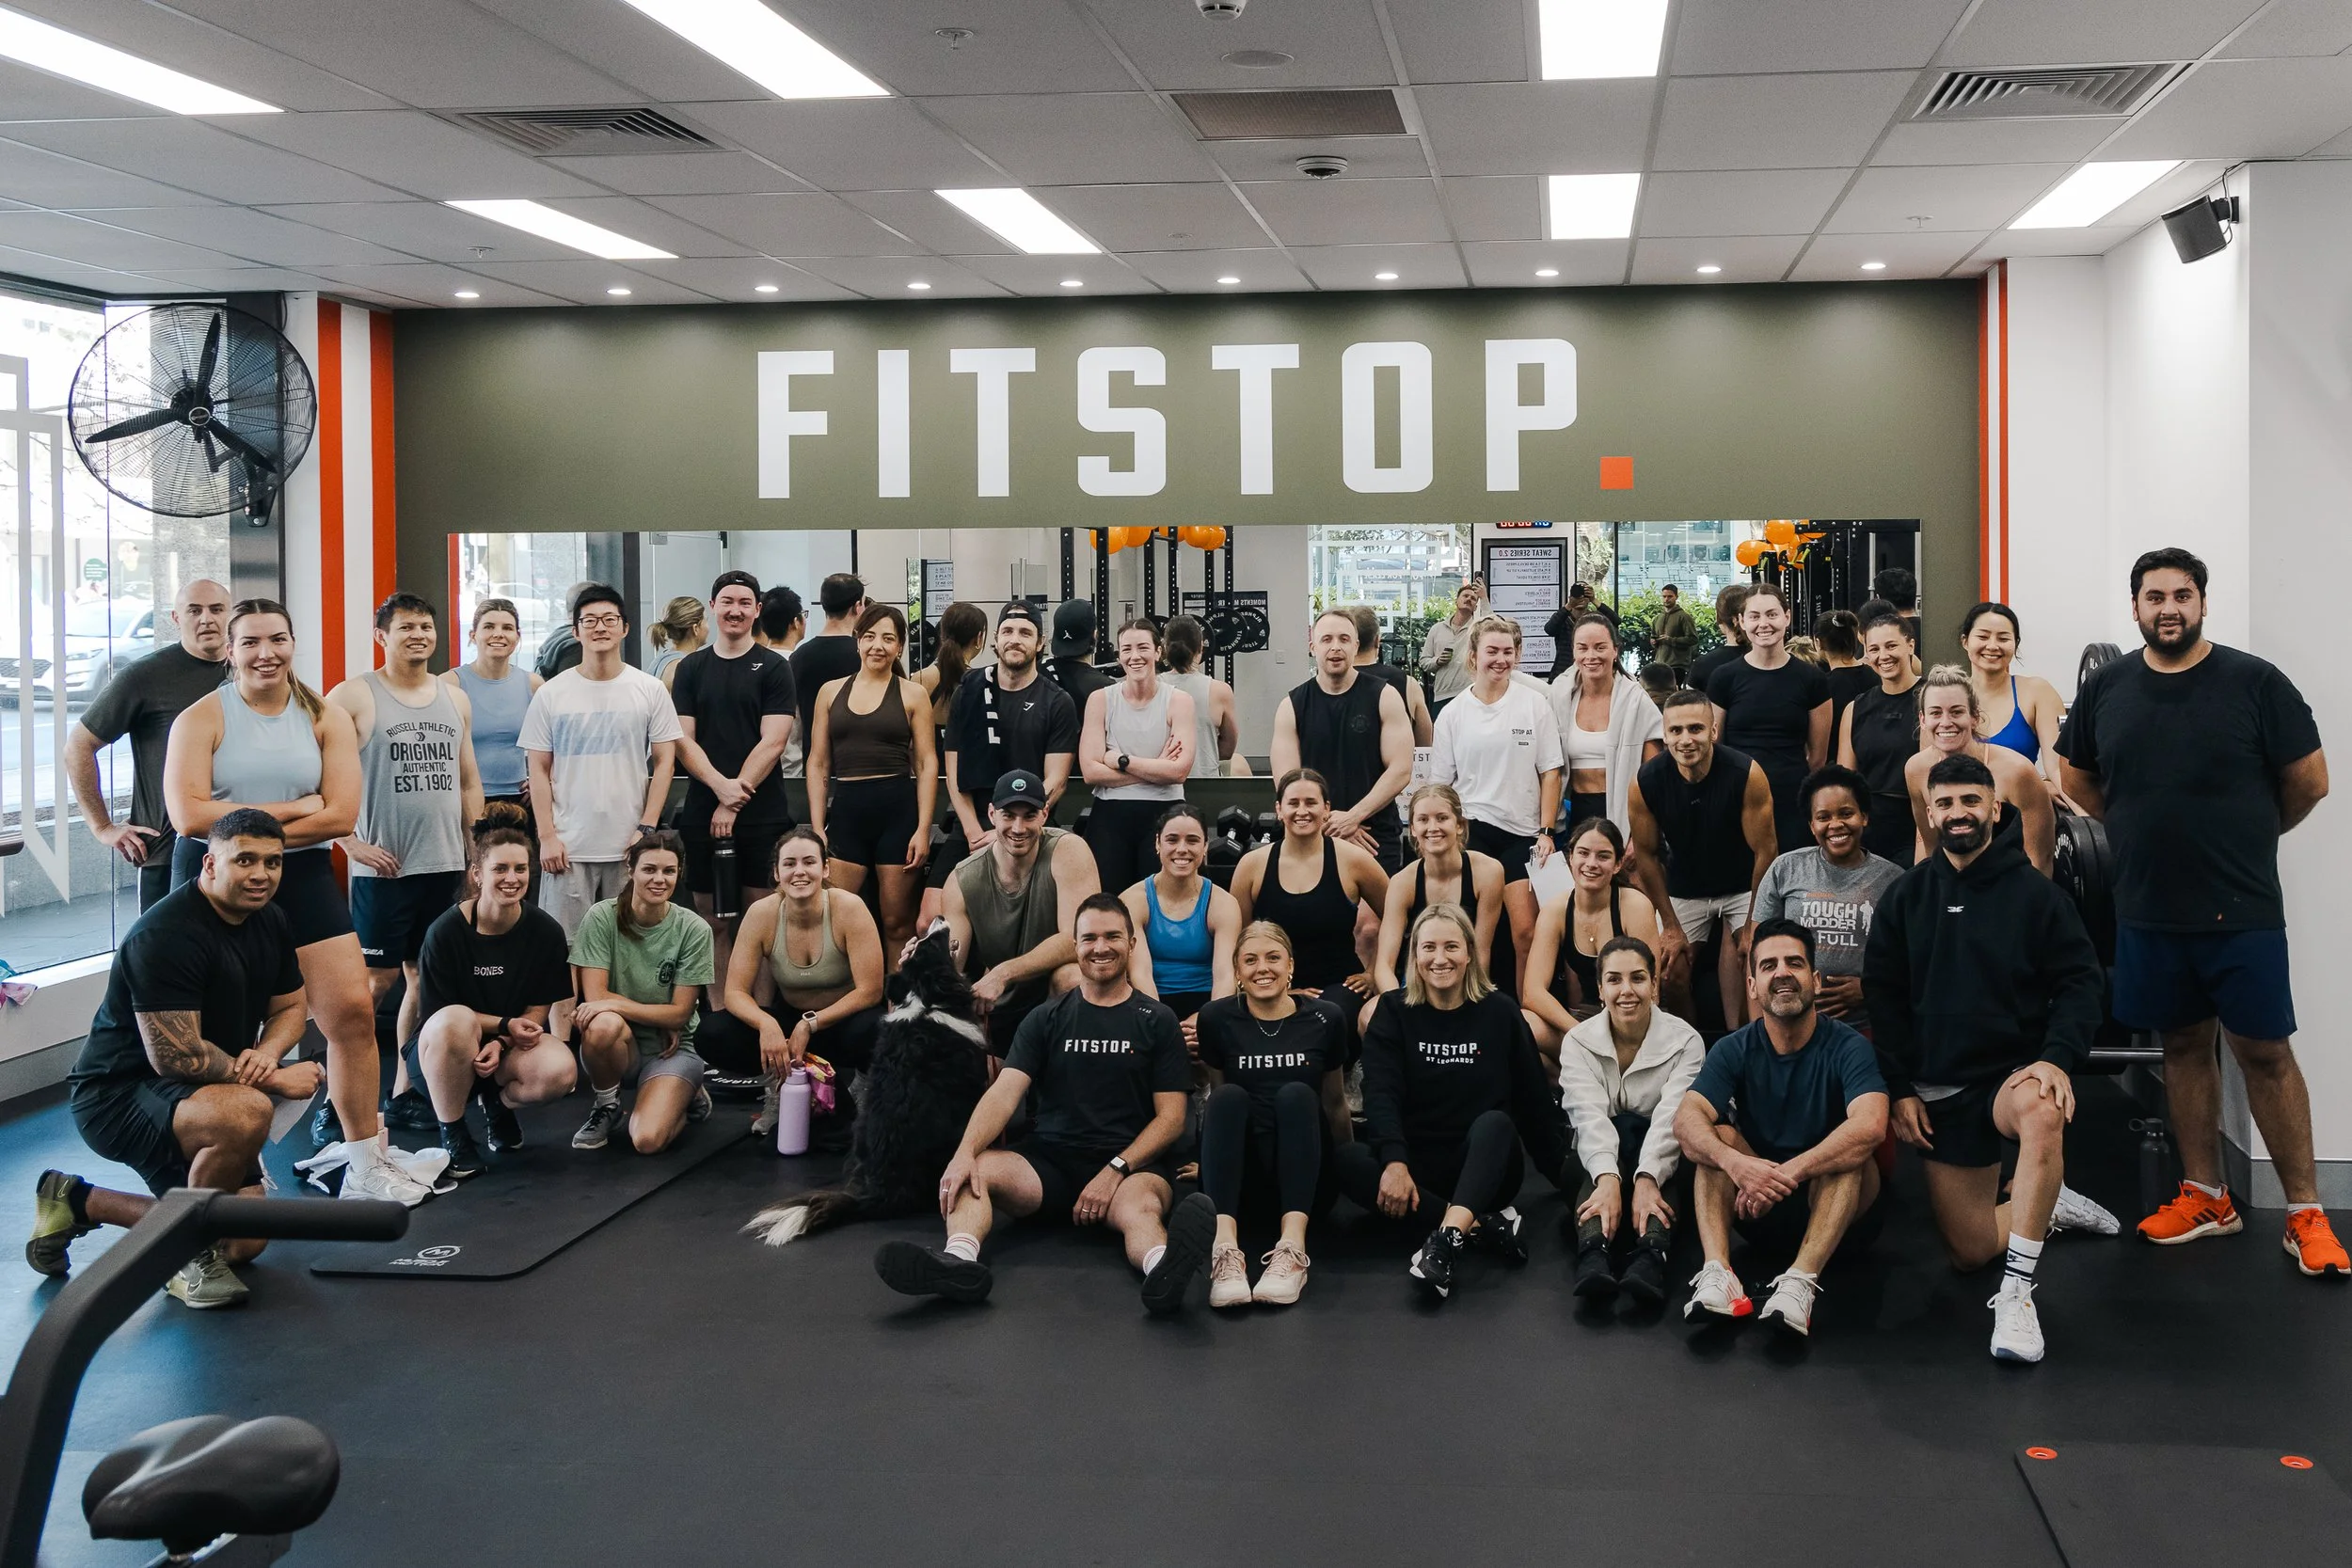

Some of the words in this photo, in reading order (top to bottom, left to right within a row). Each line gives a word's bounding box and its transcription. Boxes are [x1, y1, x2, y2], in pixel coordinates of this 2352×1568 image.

[757, 338, 1634, 499] FITSTOP.
[386, 722, 417, 737] RUSSELL
[419, 721, 456, 737] ATHLETIC
[389, 742, 453, 761] ORIGINAL
[403, 762, 447, 773] AUTHENTIC
[1802, 901, 1858, 920] TOUGH
[1800, 916, 1856, 931] MUDDER
[1818, 932, 1859, 947] FULL
[473, 965, 504, 976] BONES
[1064, 1039, 1135, 1053] FITSTOP.
[1419, 1041, 1481, 1056] FITSTOP.
[1238, 1053, 1310, 1069] FITSTOP.
